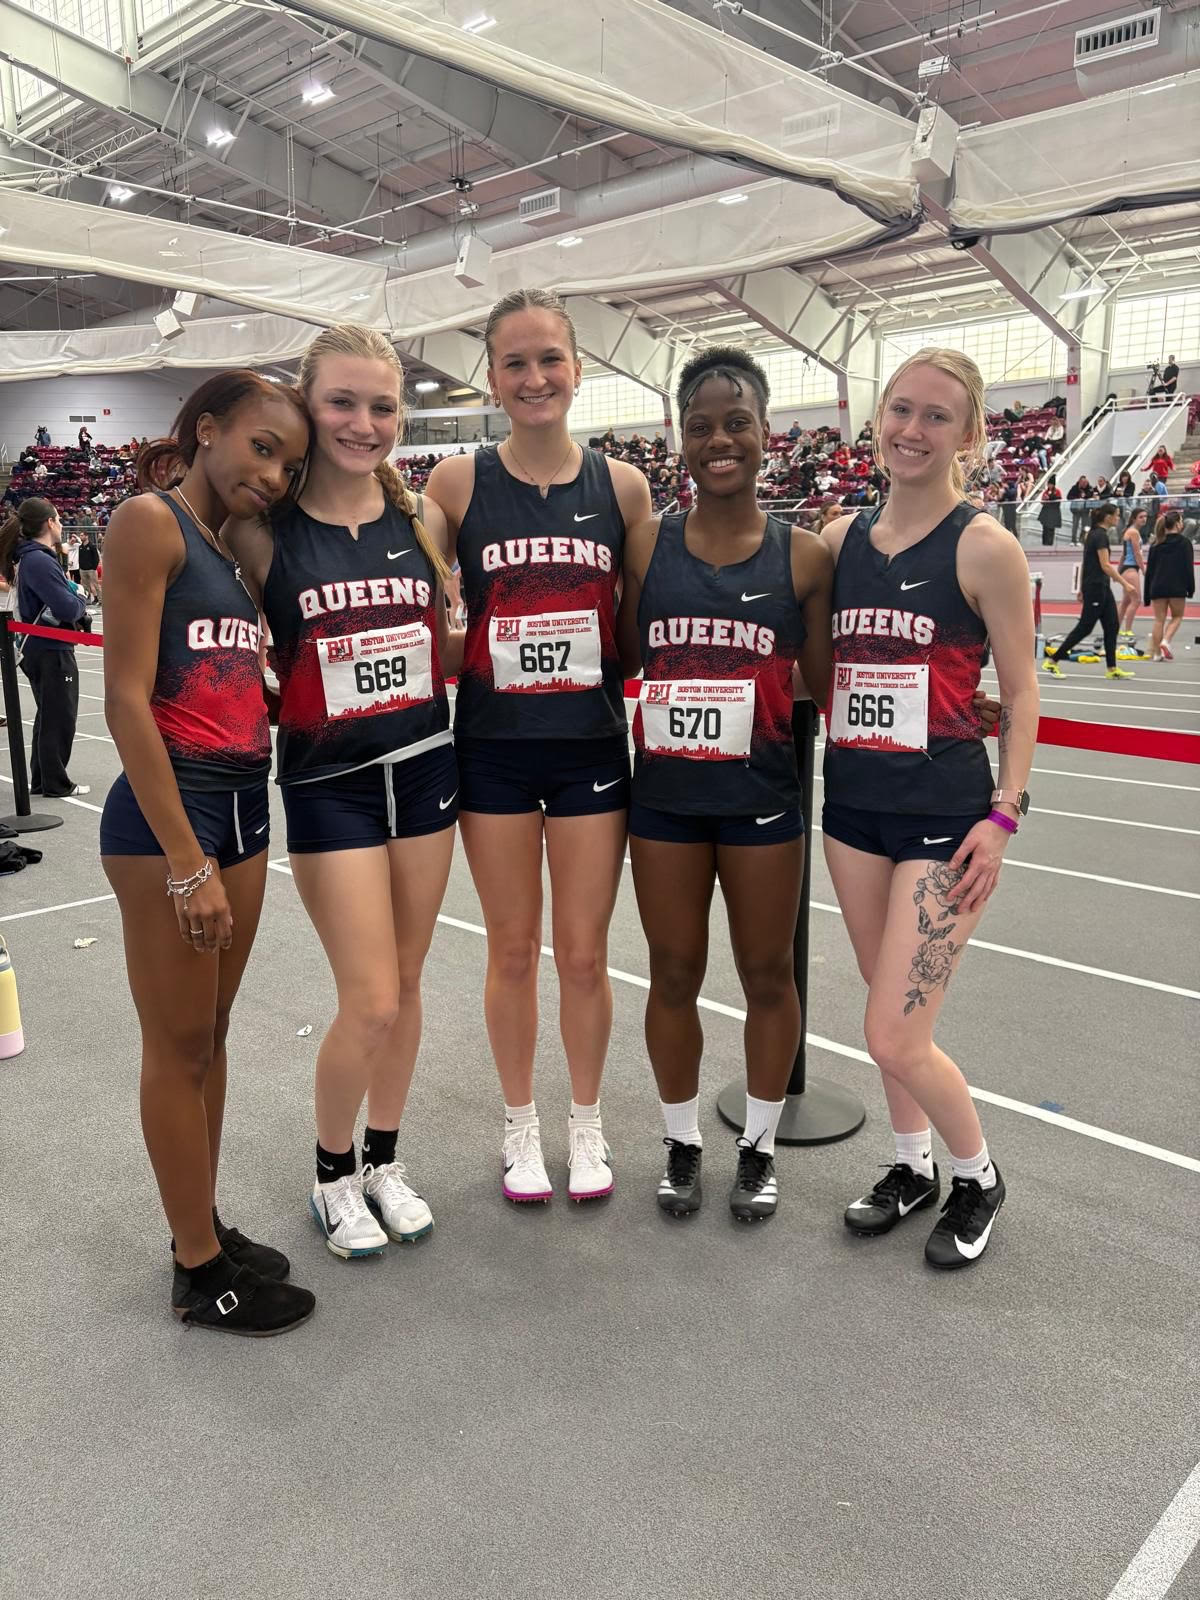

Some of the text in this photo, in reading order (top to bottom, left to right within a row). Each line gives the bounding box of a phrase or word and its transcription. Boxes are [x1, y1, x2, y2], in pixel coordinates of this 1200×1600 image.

[482, 536, 612, 573] QUEENS
[298, 577, 431, 620] QUEENS
[360, 629, 421, 646] BOSTON UNIVERSITY
[527, 616, 589, 628] BOSTON UNIVERSITY
[648, 617, 776, 656] QUEENS
[831, 608, 935, 645] QUEENS
[520, 640, 571, 673] 667
[354, 656, 407, 694] 669
[703, 686, 745, 694] UNIVERSITY
[856, 671, 917, 680] BOSTON UNIVERSITY
[669, 707, 721, 740] 670
[848, 693, 895, 728] 666
